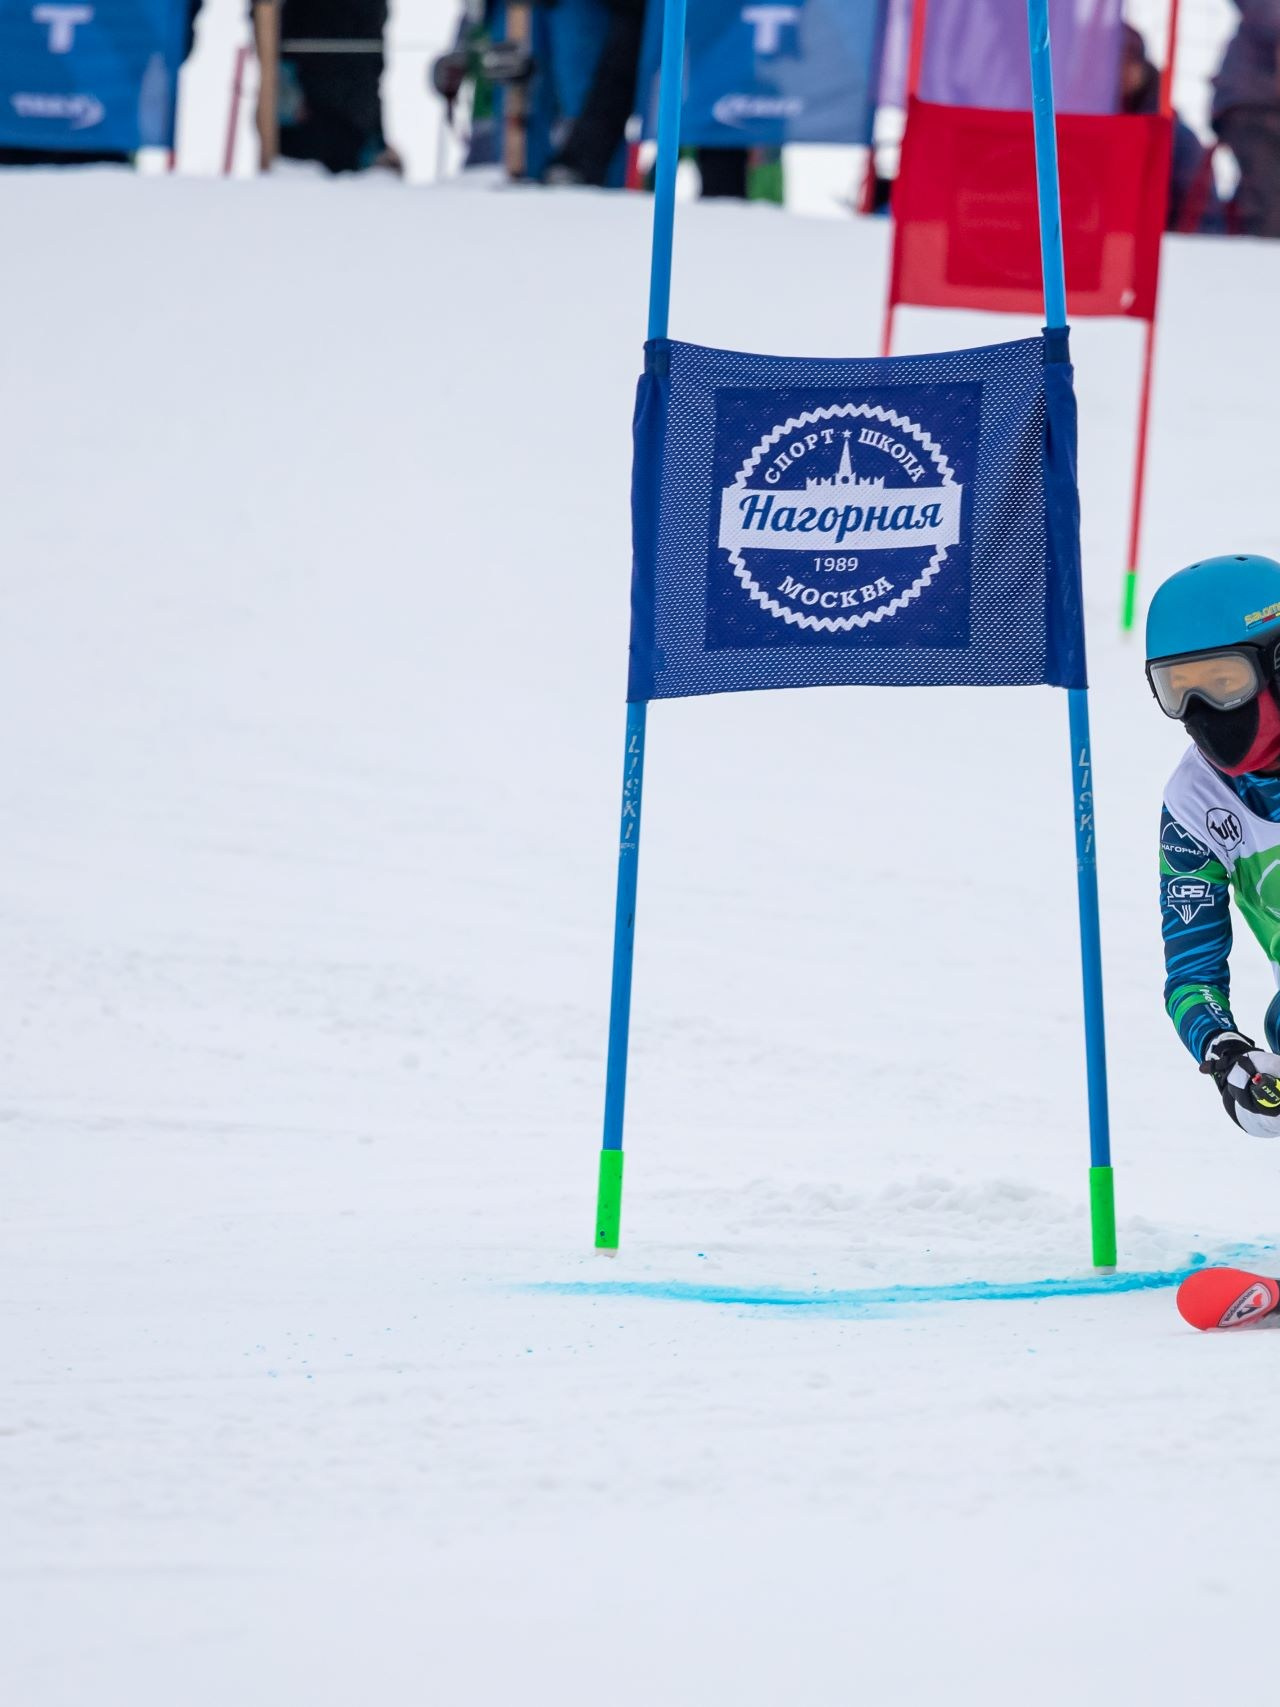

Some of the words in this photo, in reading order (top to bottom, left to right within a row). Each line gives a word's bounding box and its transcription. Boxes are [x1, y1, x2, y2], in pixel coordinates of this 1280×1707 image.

[765, 428, 834, 484] СПОРТ
[857, 428, 926, 483] ШКОЛА
[739, 494, 944, 544] Нагорная
[813, 556, 859, 572] 1989
[777, 575, 895, 608] МОСКВА
